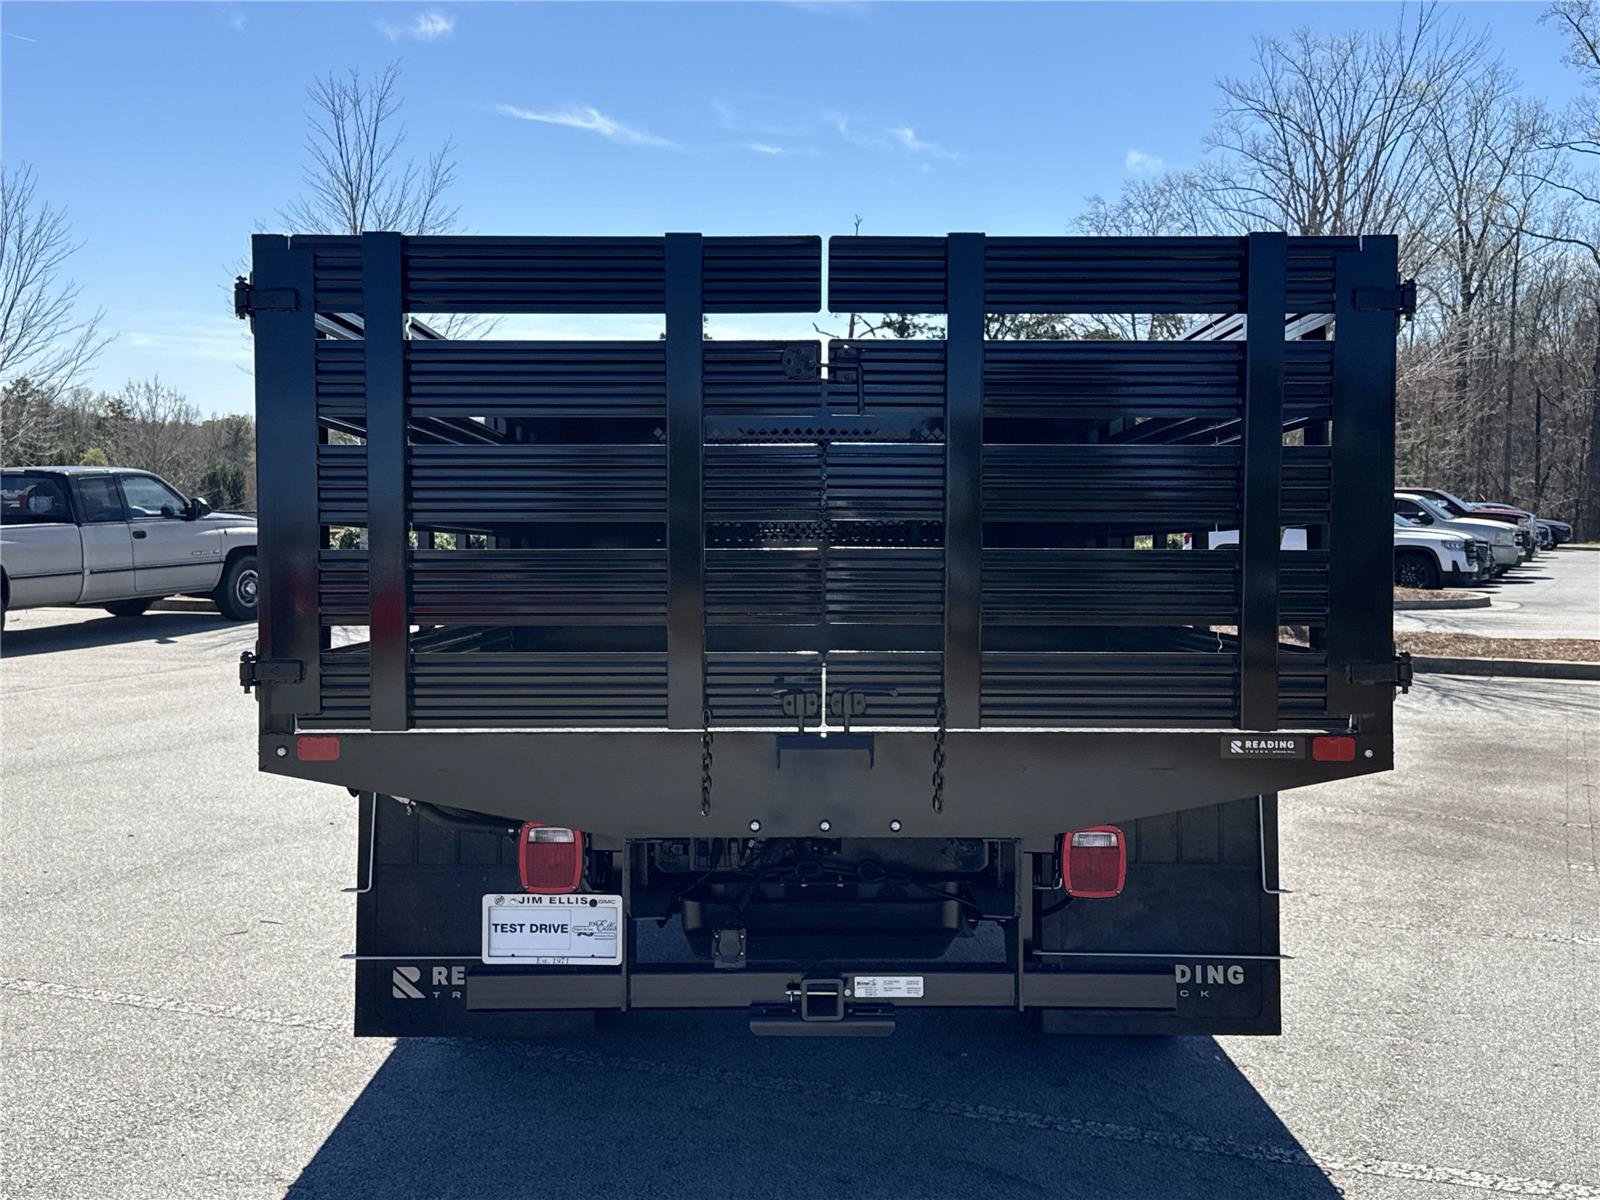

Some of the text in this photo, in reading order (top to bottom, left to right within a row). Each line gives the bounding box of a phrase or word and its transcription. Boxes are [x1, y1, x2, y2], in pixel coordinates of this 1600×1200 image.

[1245, 740, 1295, 749] READING
[518, 896, 543, 905] JIM
[548, 896, 589, 905] ELLIS
[492, 923, 525, 934] TEST
[529, 923, 569, 934] DRIVE
[432, 966, 466, 986] RE
[1174, 964, 1245, 985] DING
[432, 991, 461, 999] TR
[1179, 989, 1210, 998] CK
